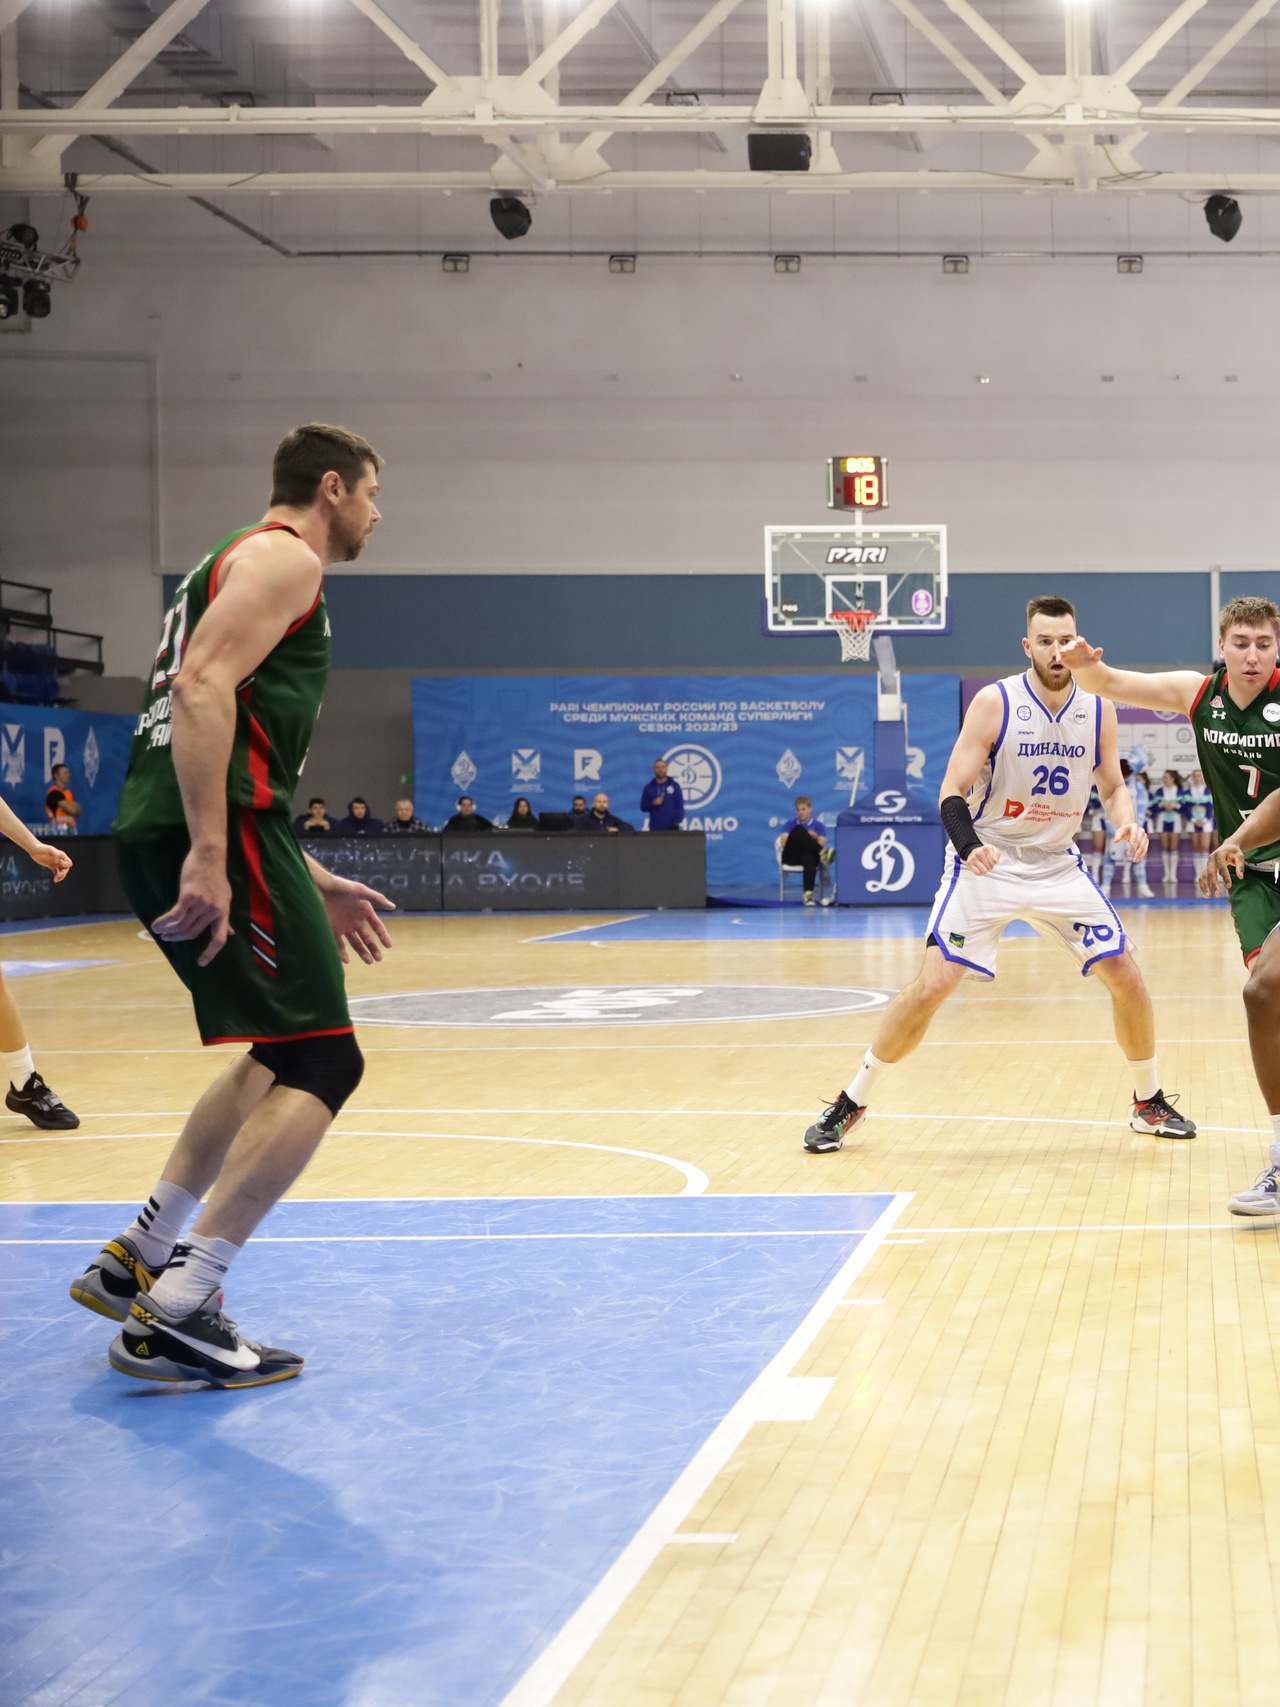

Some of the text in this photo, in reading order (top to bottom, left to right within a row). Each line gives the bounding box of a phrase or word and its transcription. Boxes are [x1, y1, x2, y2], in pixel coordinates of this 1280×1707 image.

[854, 475, 879, 505] 18
[827, 547, 888, 563] PARI
[582, 702, 660, 712] ЧЕМПИОНАТ
[664, 702, 715, 711] РОССИИ
[719, 702, 737, 711] ПО
[740, 701, 825, 711] БАСКЕТБОЛУ
[563, 711, 813, 722] СРЕДИ МУЖСКИХ КОМАНД СУПЕРЛИГИ
[639, 723, 738, 732] СЕЗОН 2022/23
[1017, 742, 1086, 758] ДИНАМО
[1031, 765, 1070, 796] 26
[895, 816, 923, 824] Sports
[1073, 922, 1114, 948] 26
